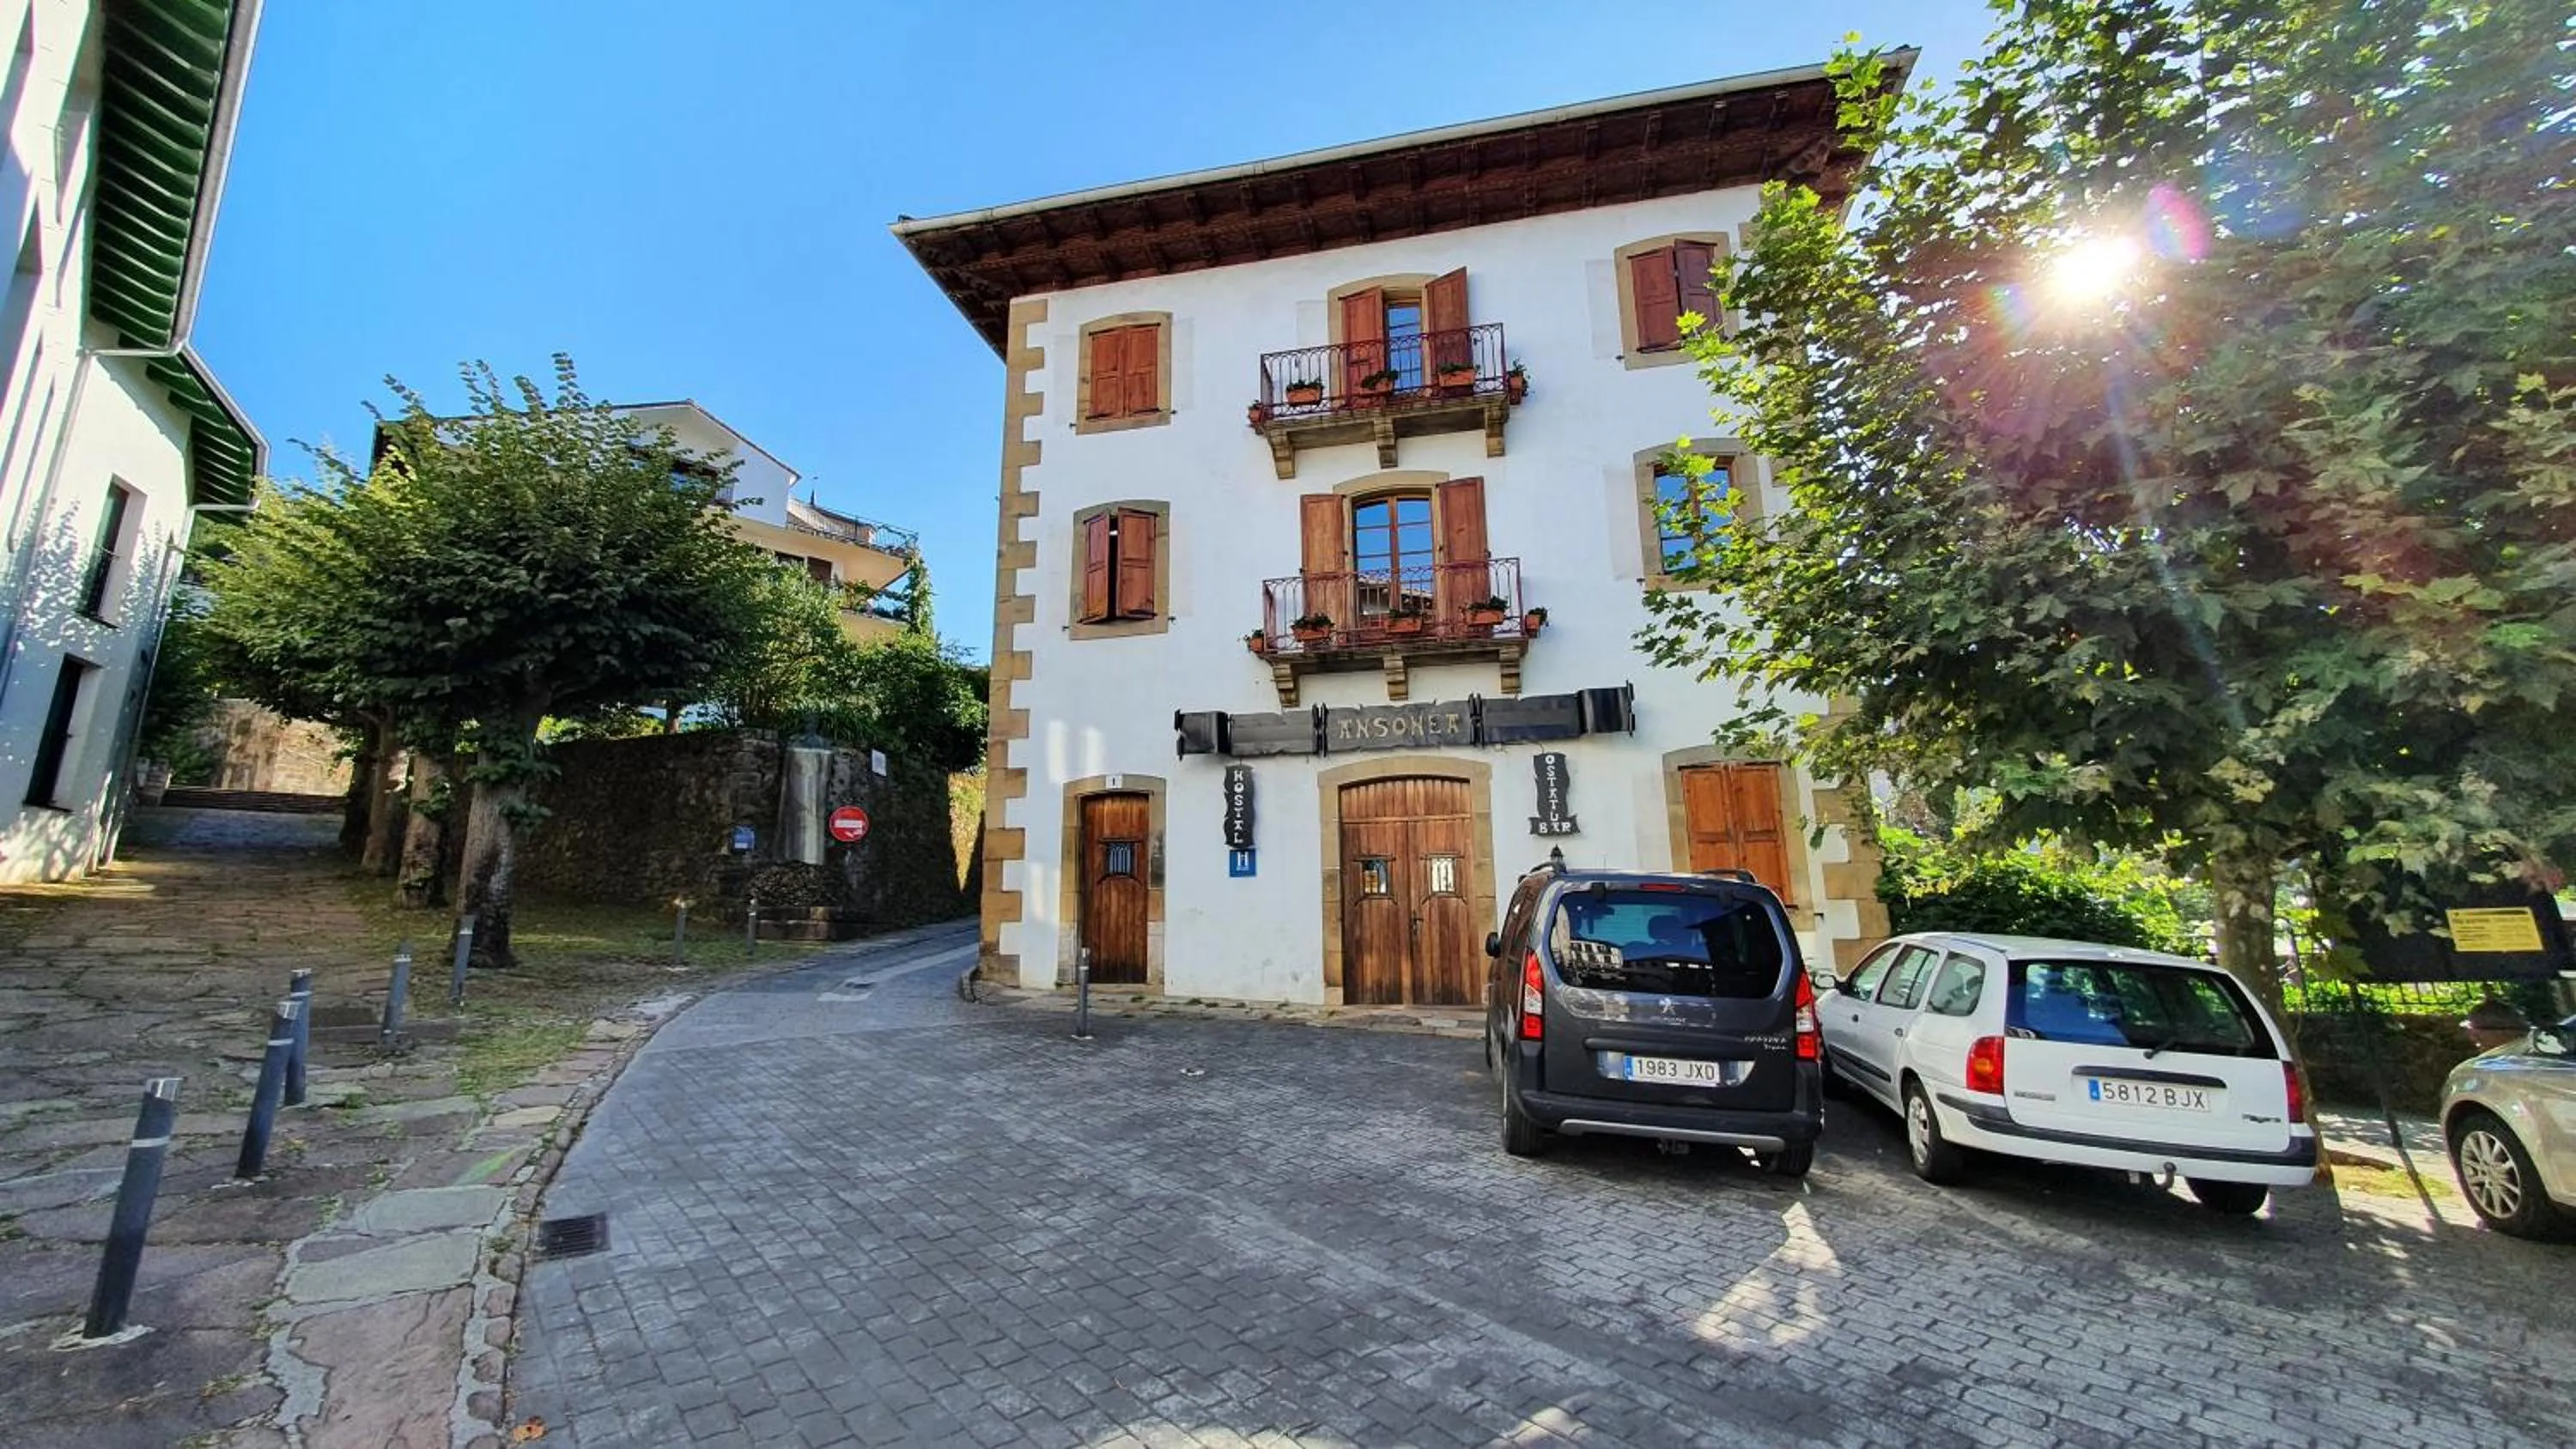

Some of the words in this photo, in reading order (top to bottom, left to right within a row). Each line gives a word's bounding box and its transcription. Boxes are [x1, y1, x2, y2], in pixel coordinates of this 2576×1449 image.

[1337, 713, 1459, 739] ANSONEA
[1546, 755, 1558, 822] OSTATU
[1234, 770, 1244, 843] HOSTAL
[1539, 822, 1571, 834] BAR
[1637, 1059, 1678, 1077] 1983
[2103, 1082, 2158, 1104] 5812
[2165, 1088, 2205, 1110] BJX
